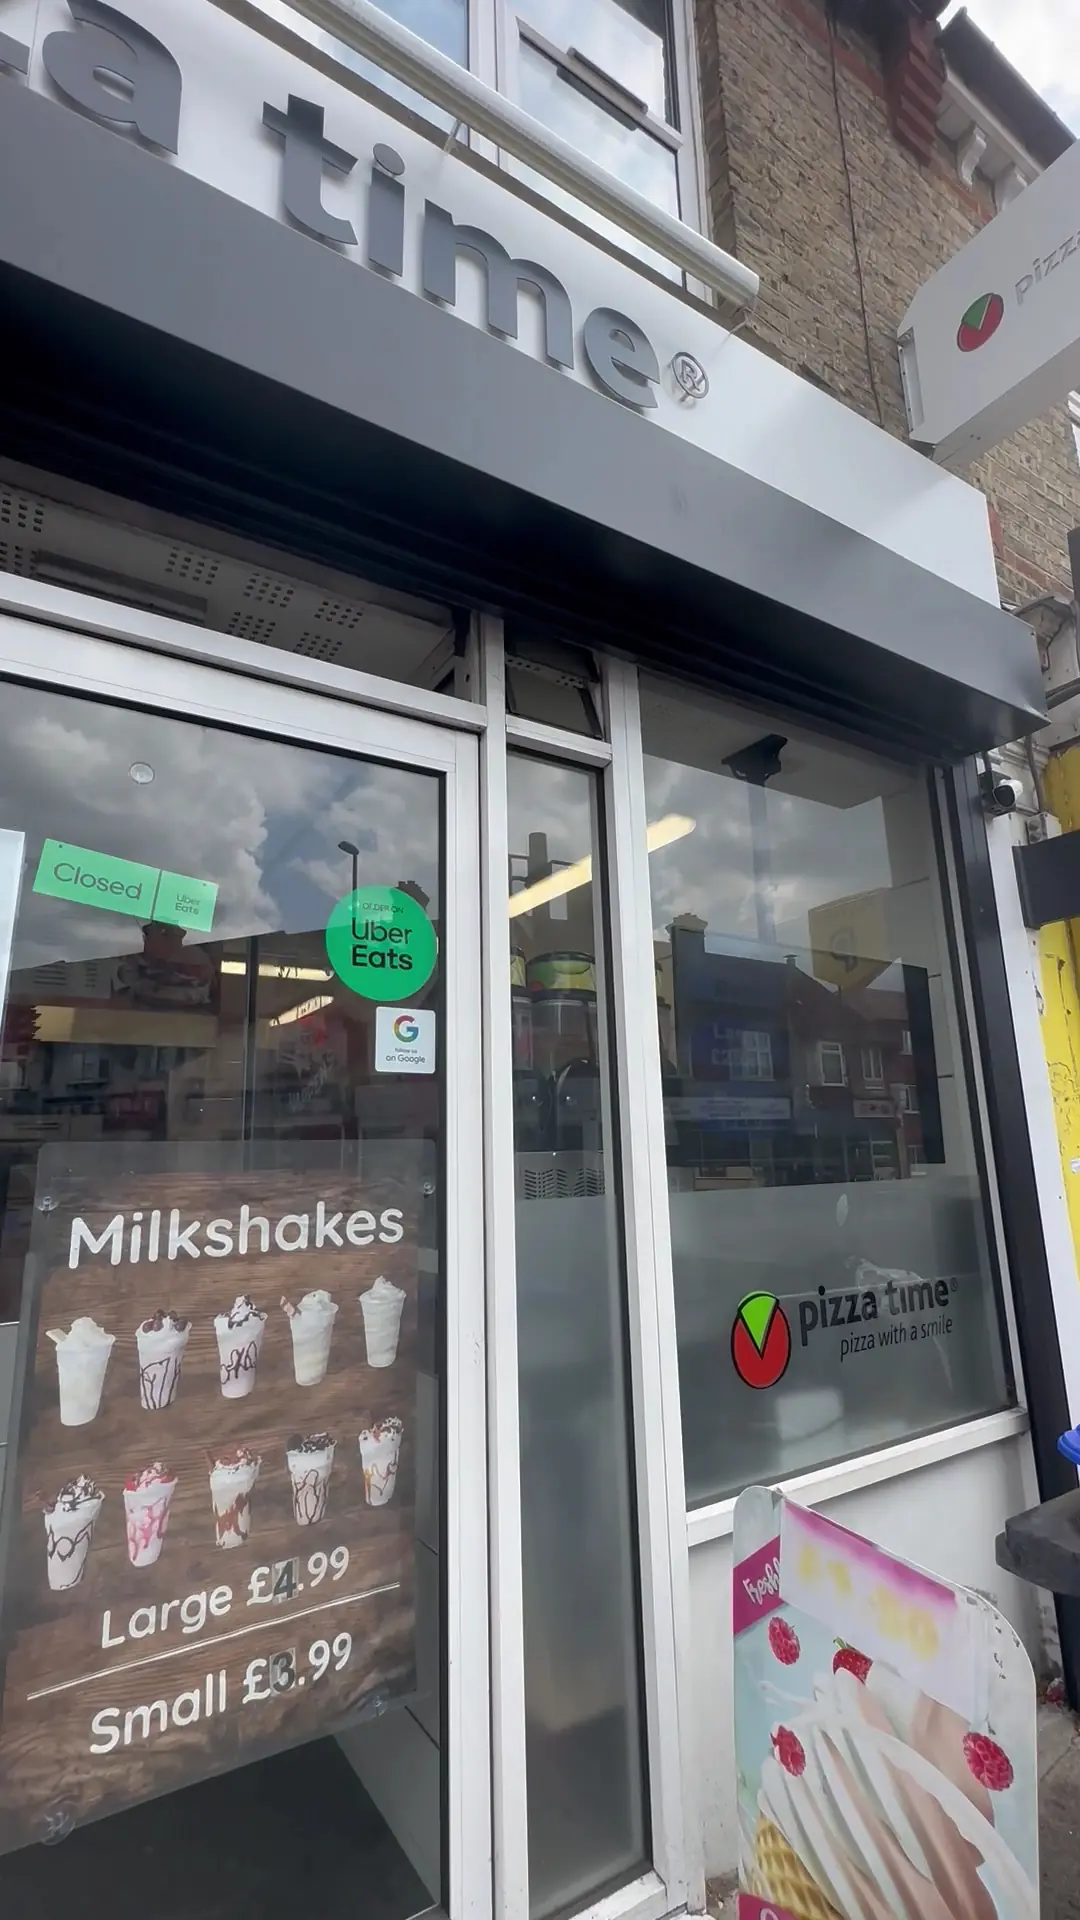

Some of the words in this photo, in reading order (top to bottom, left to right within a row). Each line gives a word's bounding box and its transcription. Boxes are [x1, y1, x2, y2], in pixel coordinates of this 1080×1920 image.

[1015, 229, 1080, 306] pizz
[53, 862, 143, 900] Closed
[176, 893, 201, 906] Uber
[175, 902, 200, 915] Eats
[351, 917, 413, 945] Uber
[351, 943, 413, 971] Eats
[397, 1054, 426, 1065] Google
[68, 1200, 404, 1269] Milkshakes
[798, 1285, 879, 1347] pizza
[840, 1332, 875, 1363] pizza
[877, 1320, 907, 1347] with
[910, 1325, 918, 1341] a
[920, 1314, 954, 1339] smile
[101, 1584, 233, 1649] Large
[246, 1545, 350, 1606] £4.99
[89, 1668, 227, 1755] Small
[242, 1631, 353, 1704] £3.99
